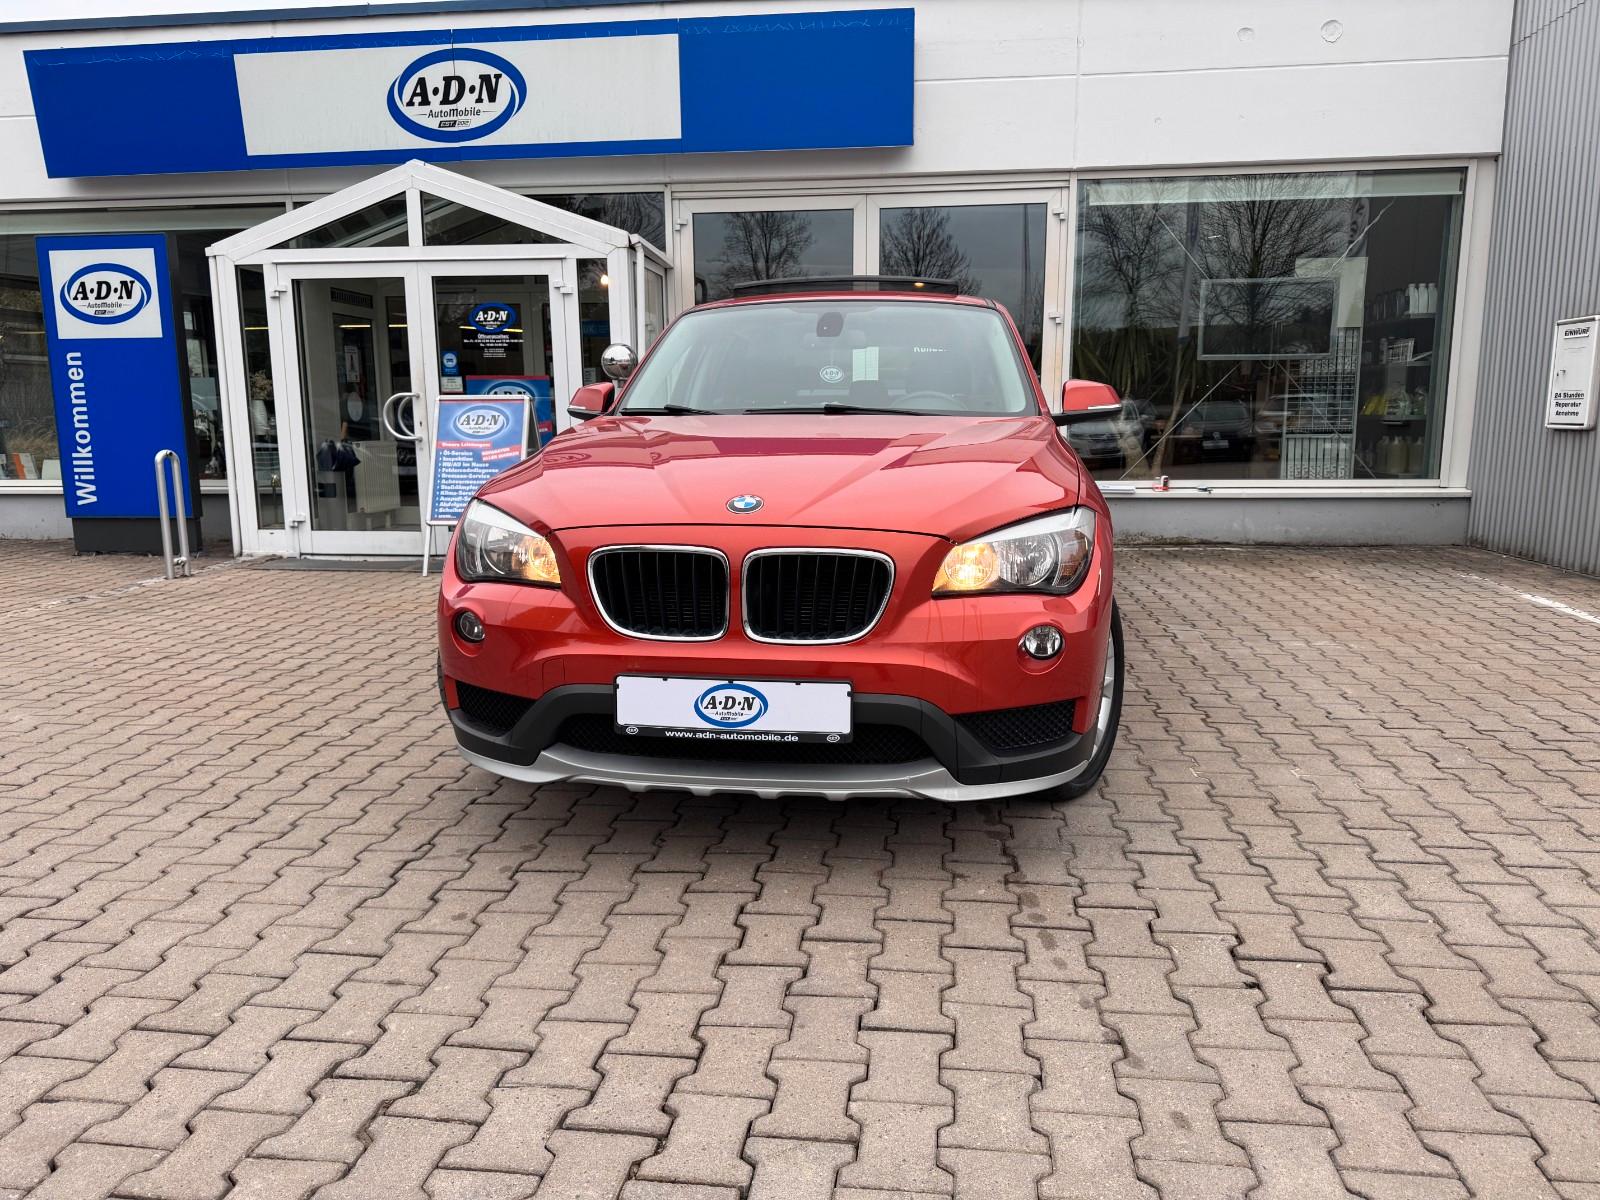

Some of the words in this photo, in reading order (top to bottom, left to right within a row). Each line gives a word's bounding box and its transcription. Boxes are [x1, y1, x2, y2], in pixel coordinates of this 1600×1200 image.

[427, 107, 481, 119] AutoMobile
[86, 301, 122, 309] AutoMobile
[1564, 327, 1590, 337] EINWURF
[1555, 401, 1581, 409] Reparatur
[66, 352, 98, 506] Willkommen
[665, 730, 799, 742] www.adn-automobile.de
